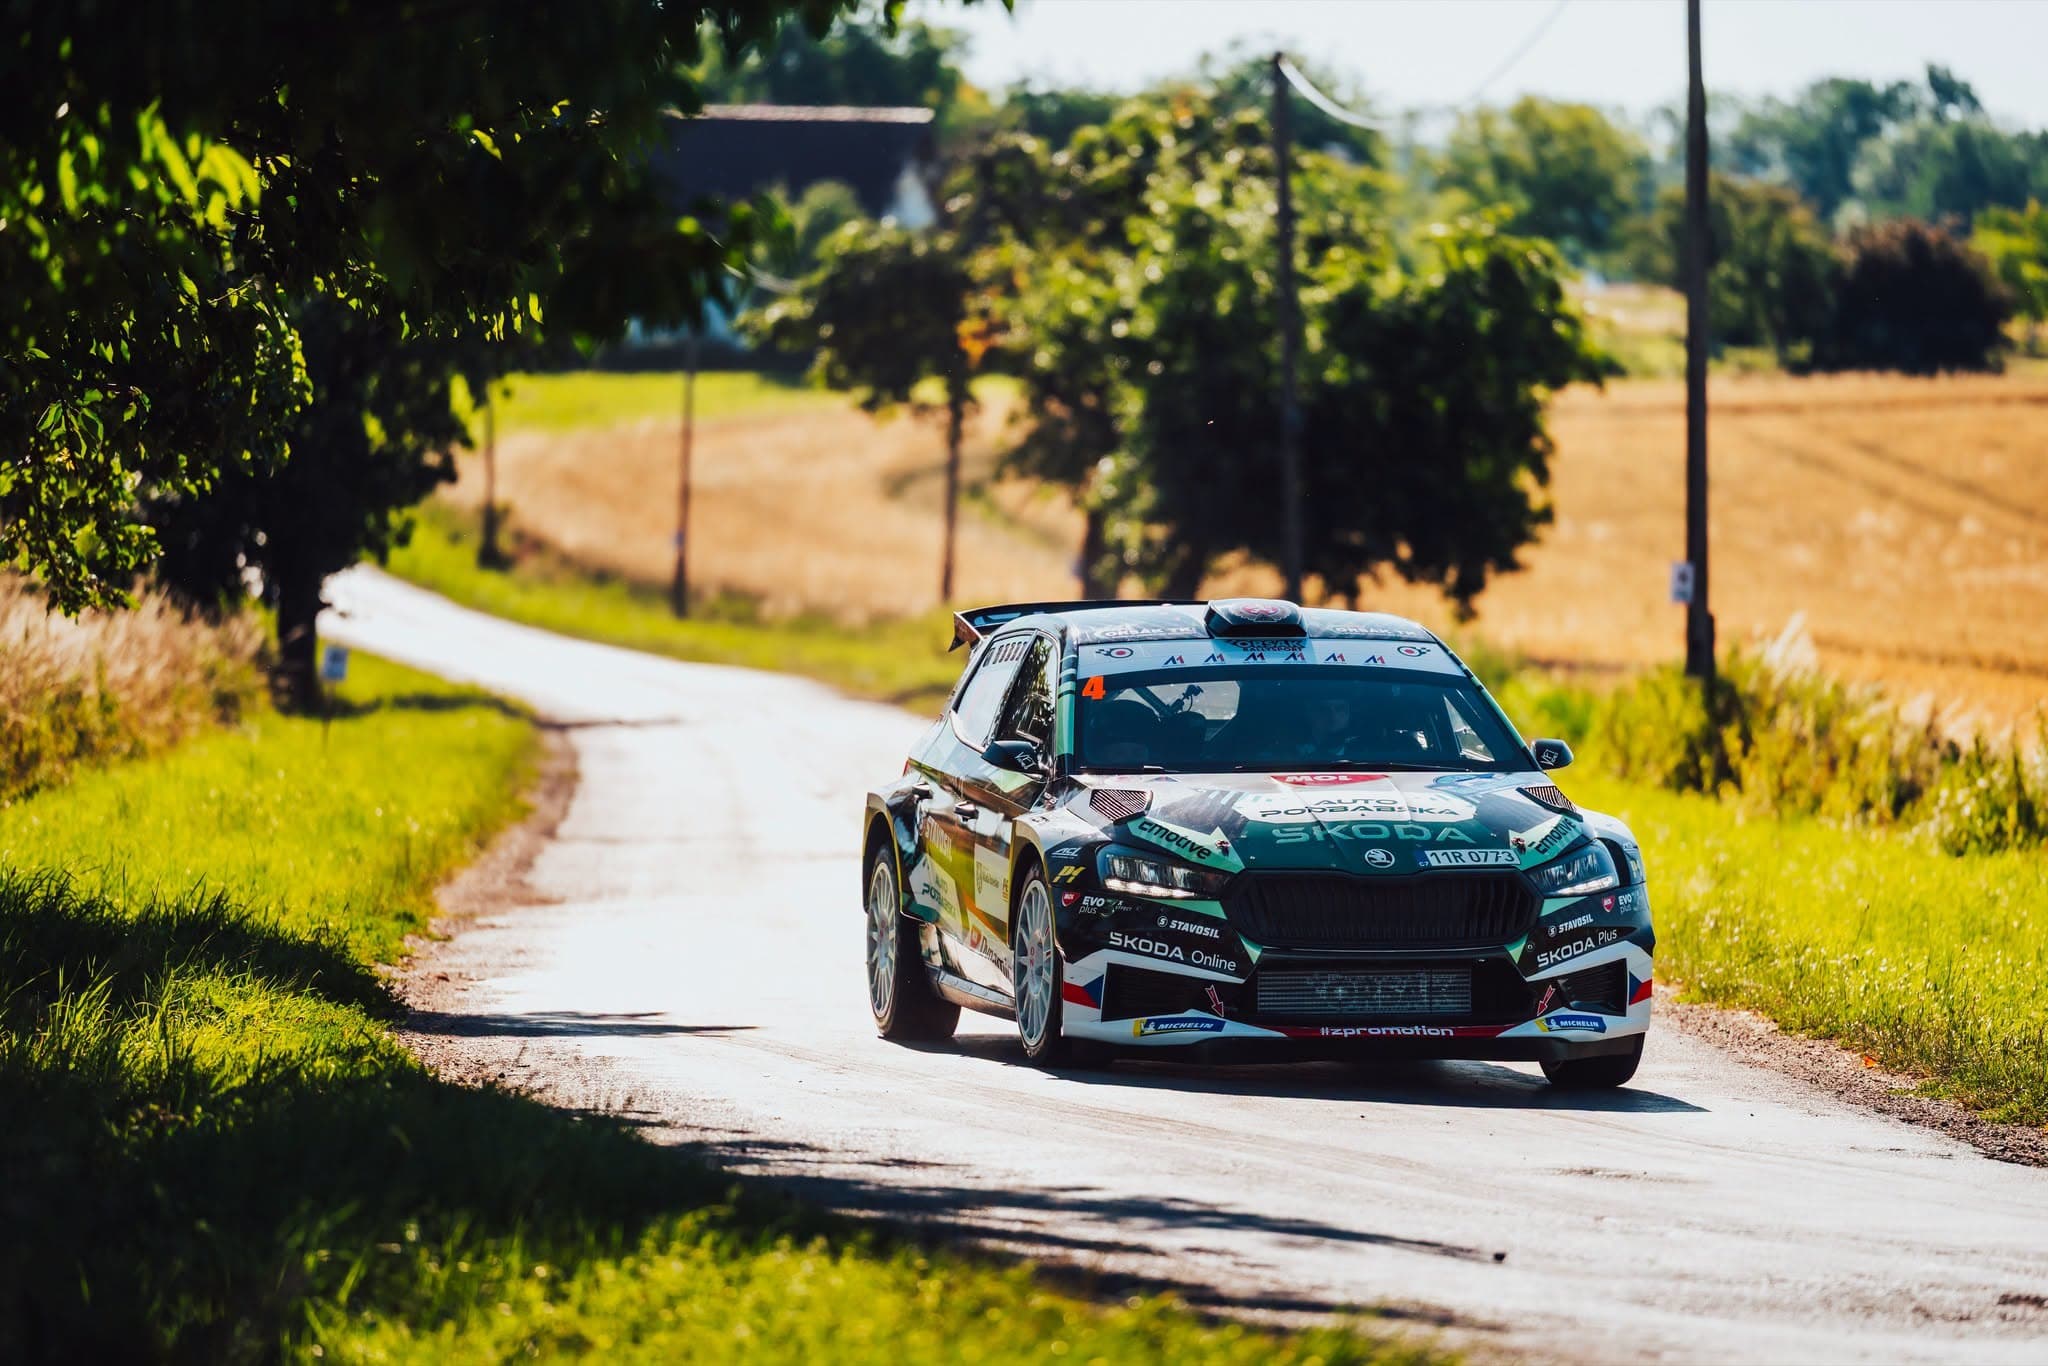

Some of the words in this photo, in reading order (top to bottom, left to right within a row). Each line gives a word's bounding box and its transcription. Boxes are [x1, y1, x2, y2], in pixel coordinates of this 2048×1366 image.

[1082, 675, 1106, 700] 4
[1429, 852, 1465, 864] 11R
[1468, 850, 1515, 863] 0773
[1083, 896, 1105, 907] EVO
[1618, 893, 1632, 905] EVO
[1079, 903, 1098, 914] plus
[1169, 920, 1220, 938] STAVOSIL
[1558, 913, 1594, 933] STAVOSIL
[1598, 929, 1618, 945] Plus
[1191, 950, 1237, 971] Online
[1158, 1022, 1214, 1030] MICHELIN
[1560, 1020, 1600, 1028] MICHELIN
